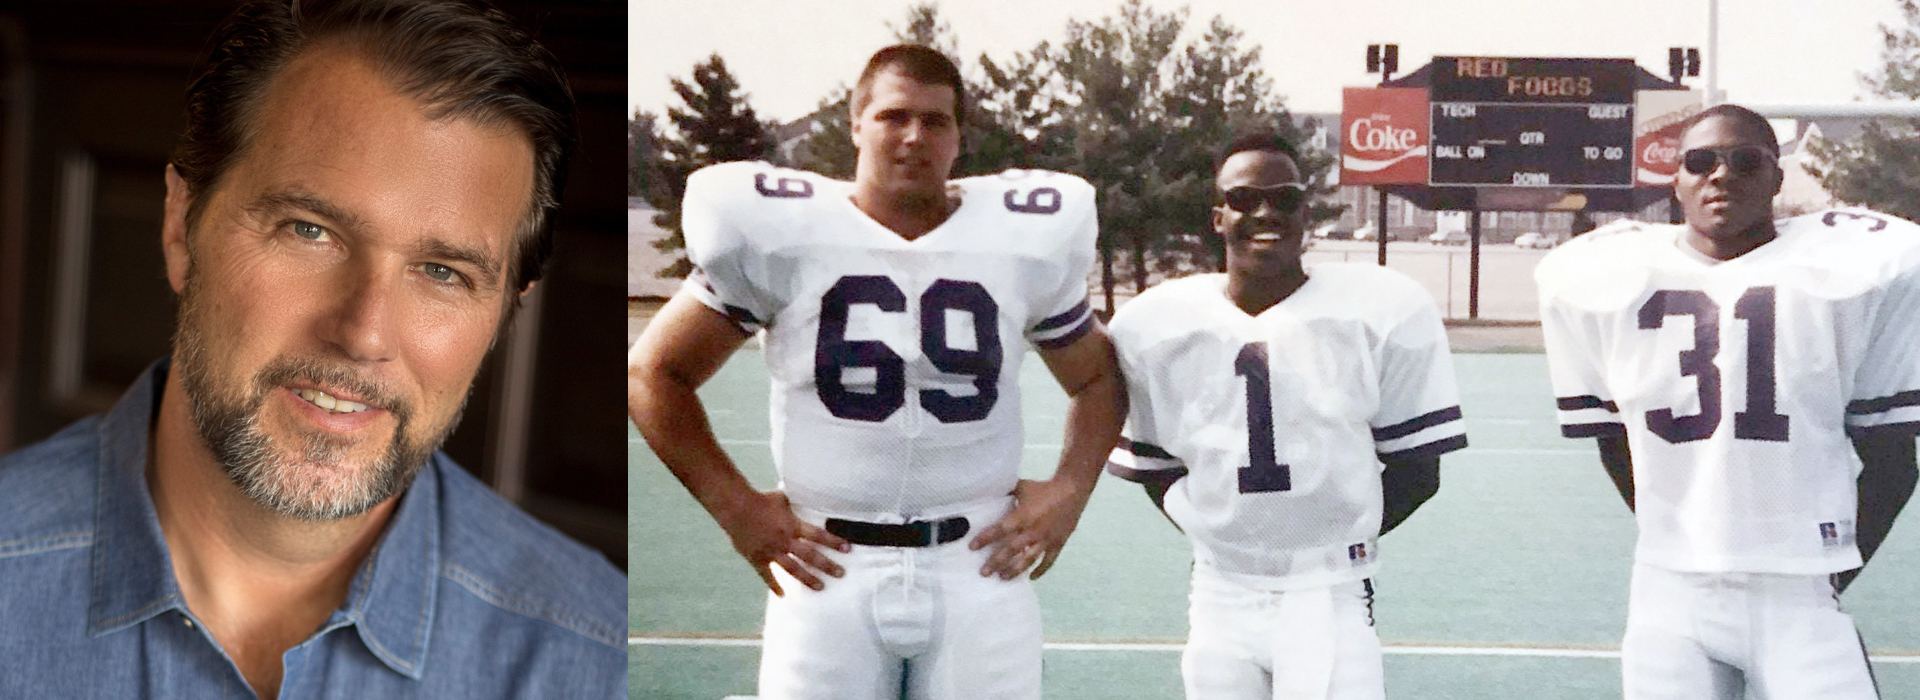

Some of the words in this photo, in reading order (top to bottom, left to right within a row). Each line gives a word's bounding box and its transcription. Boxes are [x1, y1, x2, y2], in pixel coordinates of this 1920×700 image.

[1457, 58, 1507, 77] RED
[1441, 105, 1476, 117] TECH
[1588, 107, 1628, 119] GUEST
[1350, 118, 1417, 151] Coke
[1520, 132, 1545, 145] QTR
[1436, 145, 1462, 158] BALL
[1467, 146, 1485, 159] ON
[1584, 147, 1600, 160] TO
[1604, 147, 1623, 160] GO
[1513, 172, 1549, 187] DOWN
[815, 275, 1003, 423] 69
[1638, 285, 1790, 444] 31
[1234, 341, 1291, 494] 1
